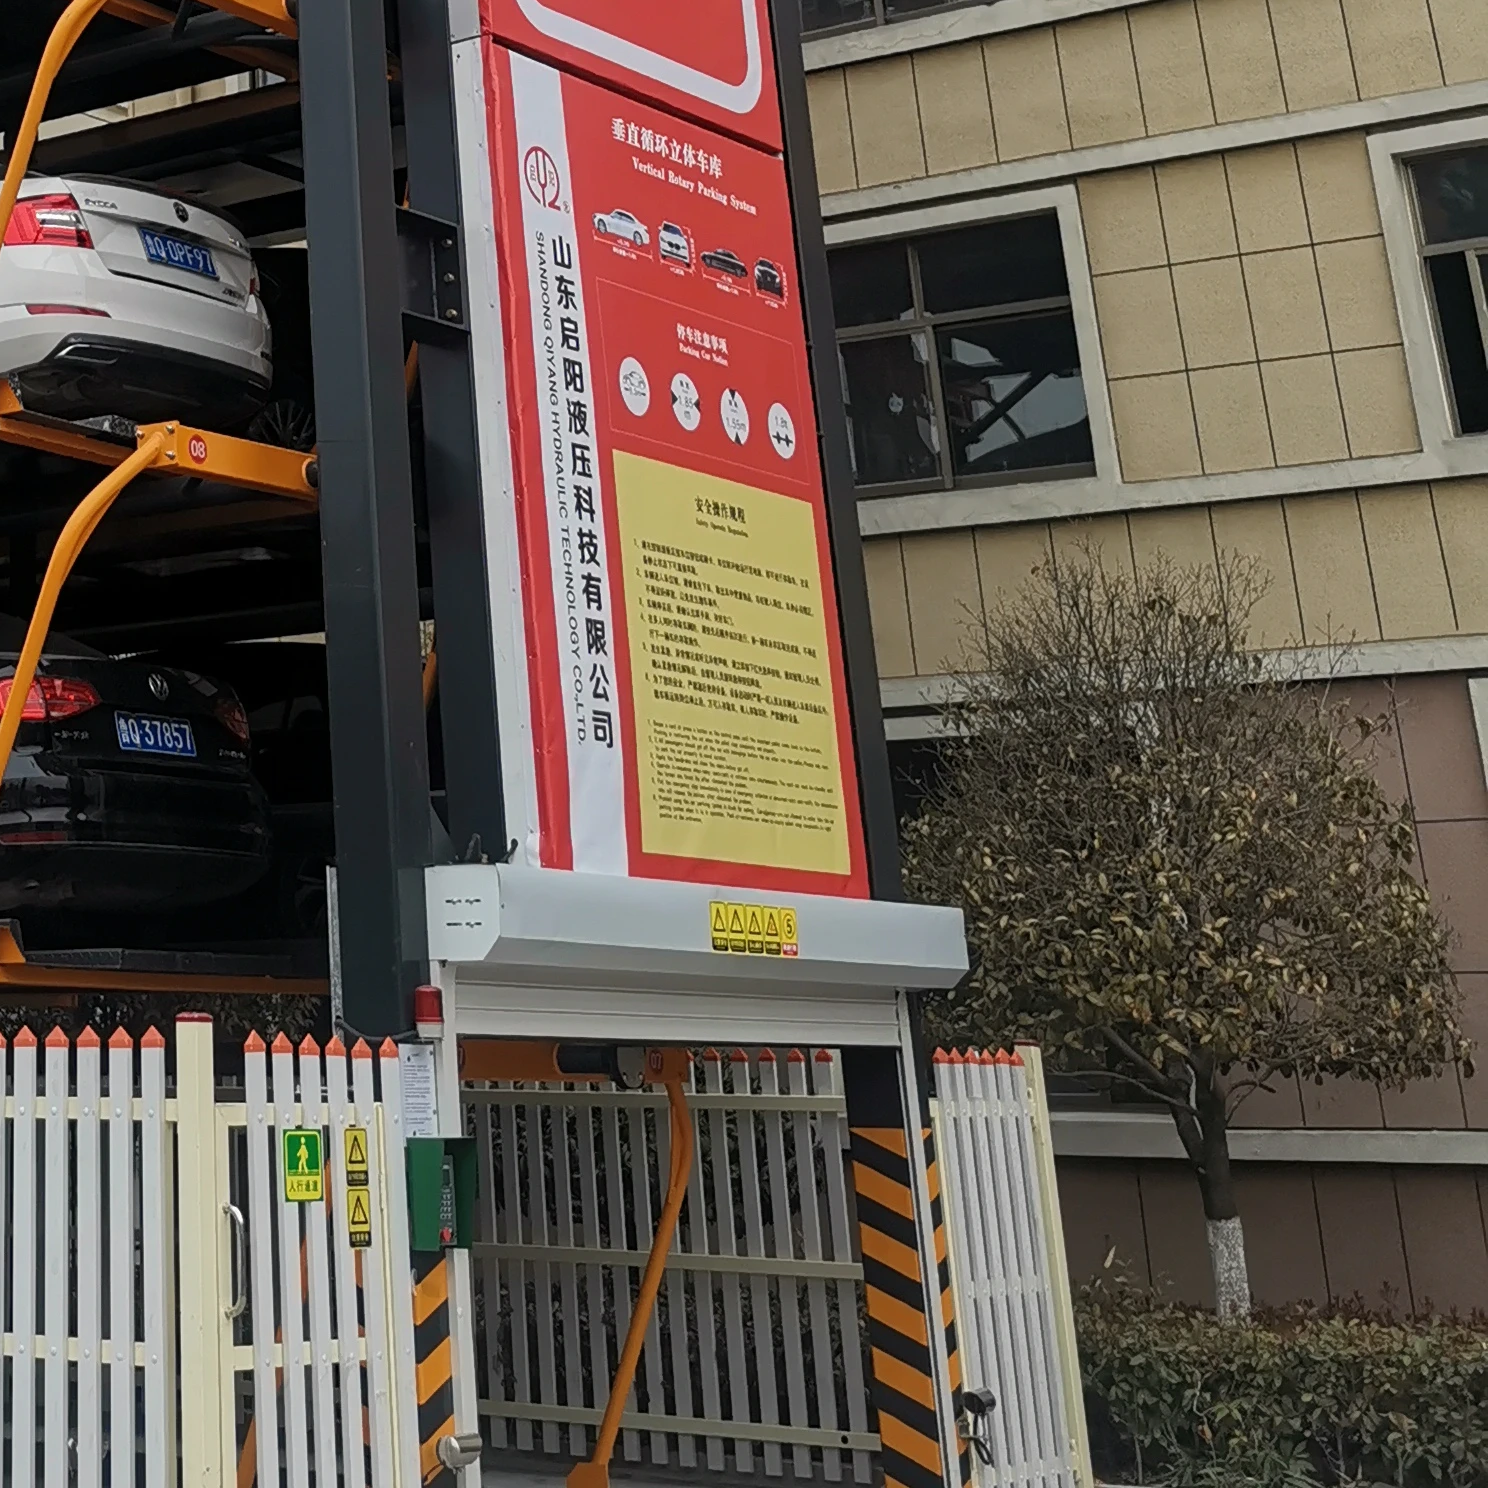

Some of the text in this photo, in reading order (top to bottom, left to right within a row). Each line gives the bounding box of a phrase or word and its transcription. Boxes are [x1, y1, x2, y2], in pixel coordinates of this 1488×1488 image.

[611, 117, 723, 179] 垂直循环立体车库
[631, 156, 757, 216] Vertical Rotary Parking System
[535, 230, 552, 330] SHANDONG
[543, 336, 559, 406] QIYANG
[190, 439, 206, 459] 08
[551, 411, 569, 519] HYDRAULIC
[551, 234, 614, 749] 山东启阳液压科技有限公司
[560, 524, 581, 660] TECHNOLOGY
[288, 1179, 319, 1193] 人行通道
